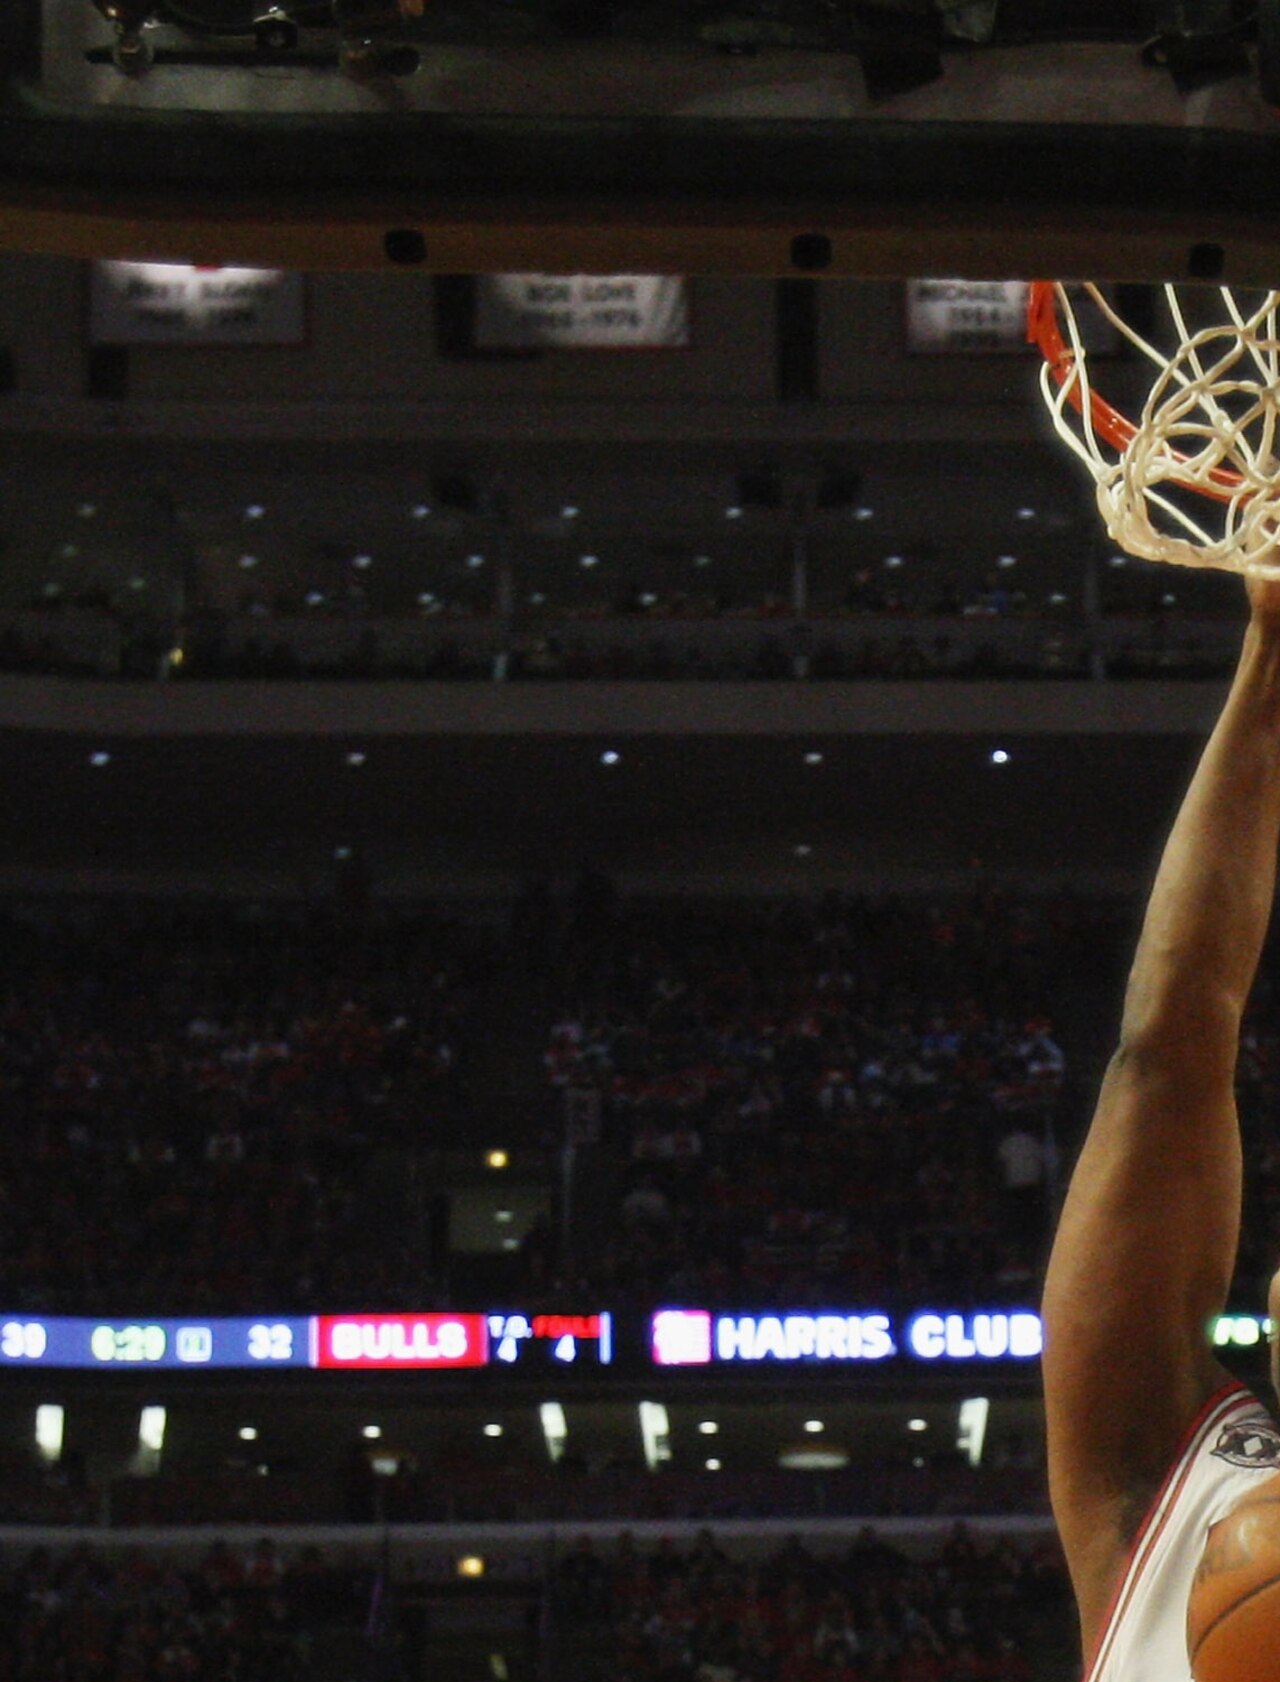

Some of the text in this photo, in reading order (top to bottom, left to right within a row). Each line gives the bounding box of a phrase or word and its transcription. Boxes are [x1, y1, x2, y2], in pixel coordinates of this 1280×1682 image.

[331, 1322, 468, 1361] BULLS
[717, 1314, 1043, 1361] HARRIS CLUB
